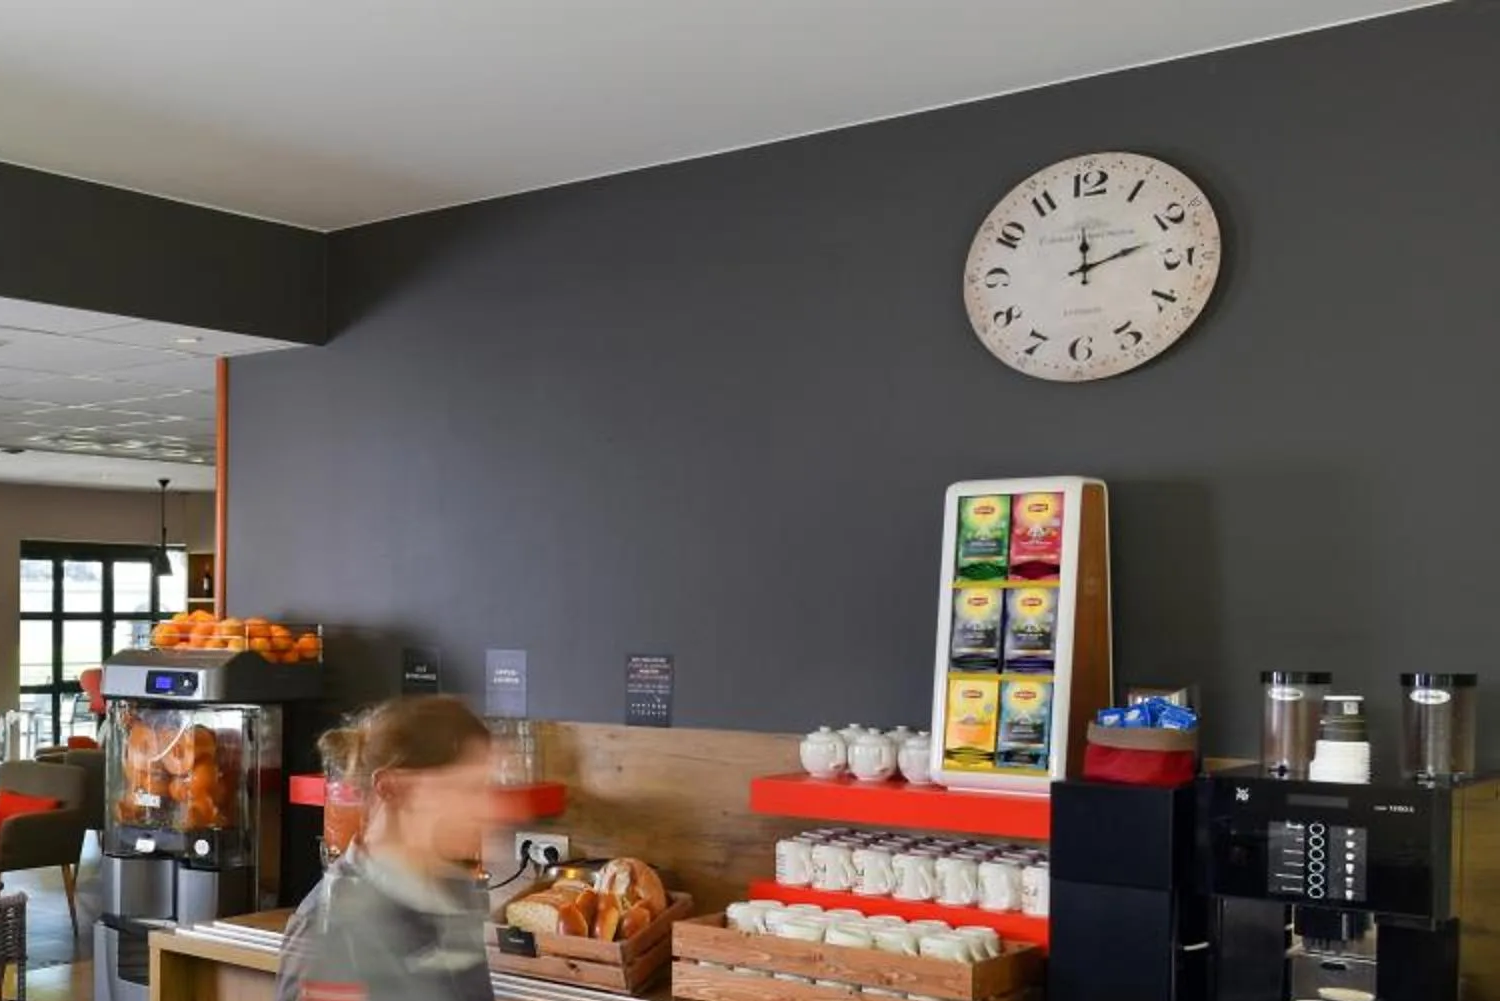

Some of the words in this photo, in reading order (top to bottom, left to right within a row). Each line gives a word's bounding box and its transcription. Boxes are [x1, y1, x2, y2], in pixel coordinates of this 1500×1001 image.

[1073, 169, 1109, 198] 12
[1126, 179, 1145, 202] 1
[1031, 189, 1057, 217] 11
[1153, 201, 1186, 231] 2
[996, 220, 1026, 249] 10
[1163, 247, 1196, 271] 3
[984, 267, 1011, 289] 9
[992, 303, 1023, 328] 8
[1024, 328, 1050, 356] 7
[1067, 335, 1094, 363] 6
[1113, 320, 1143, 351] 5
